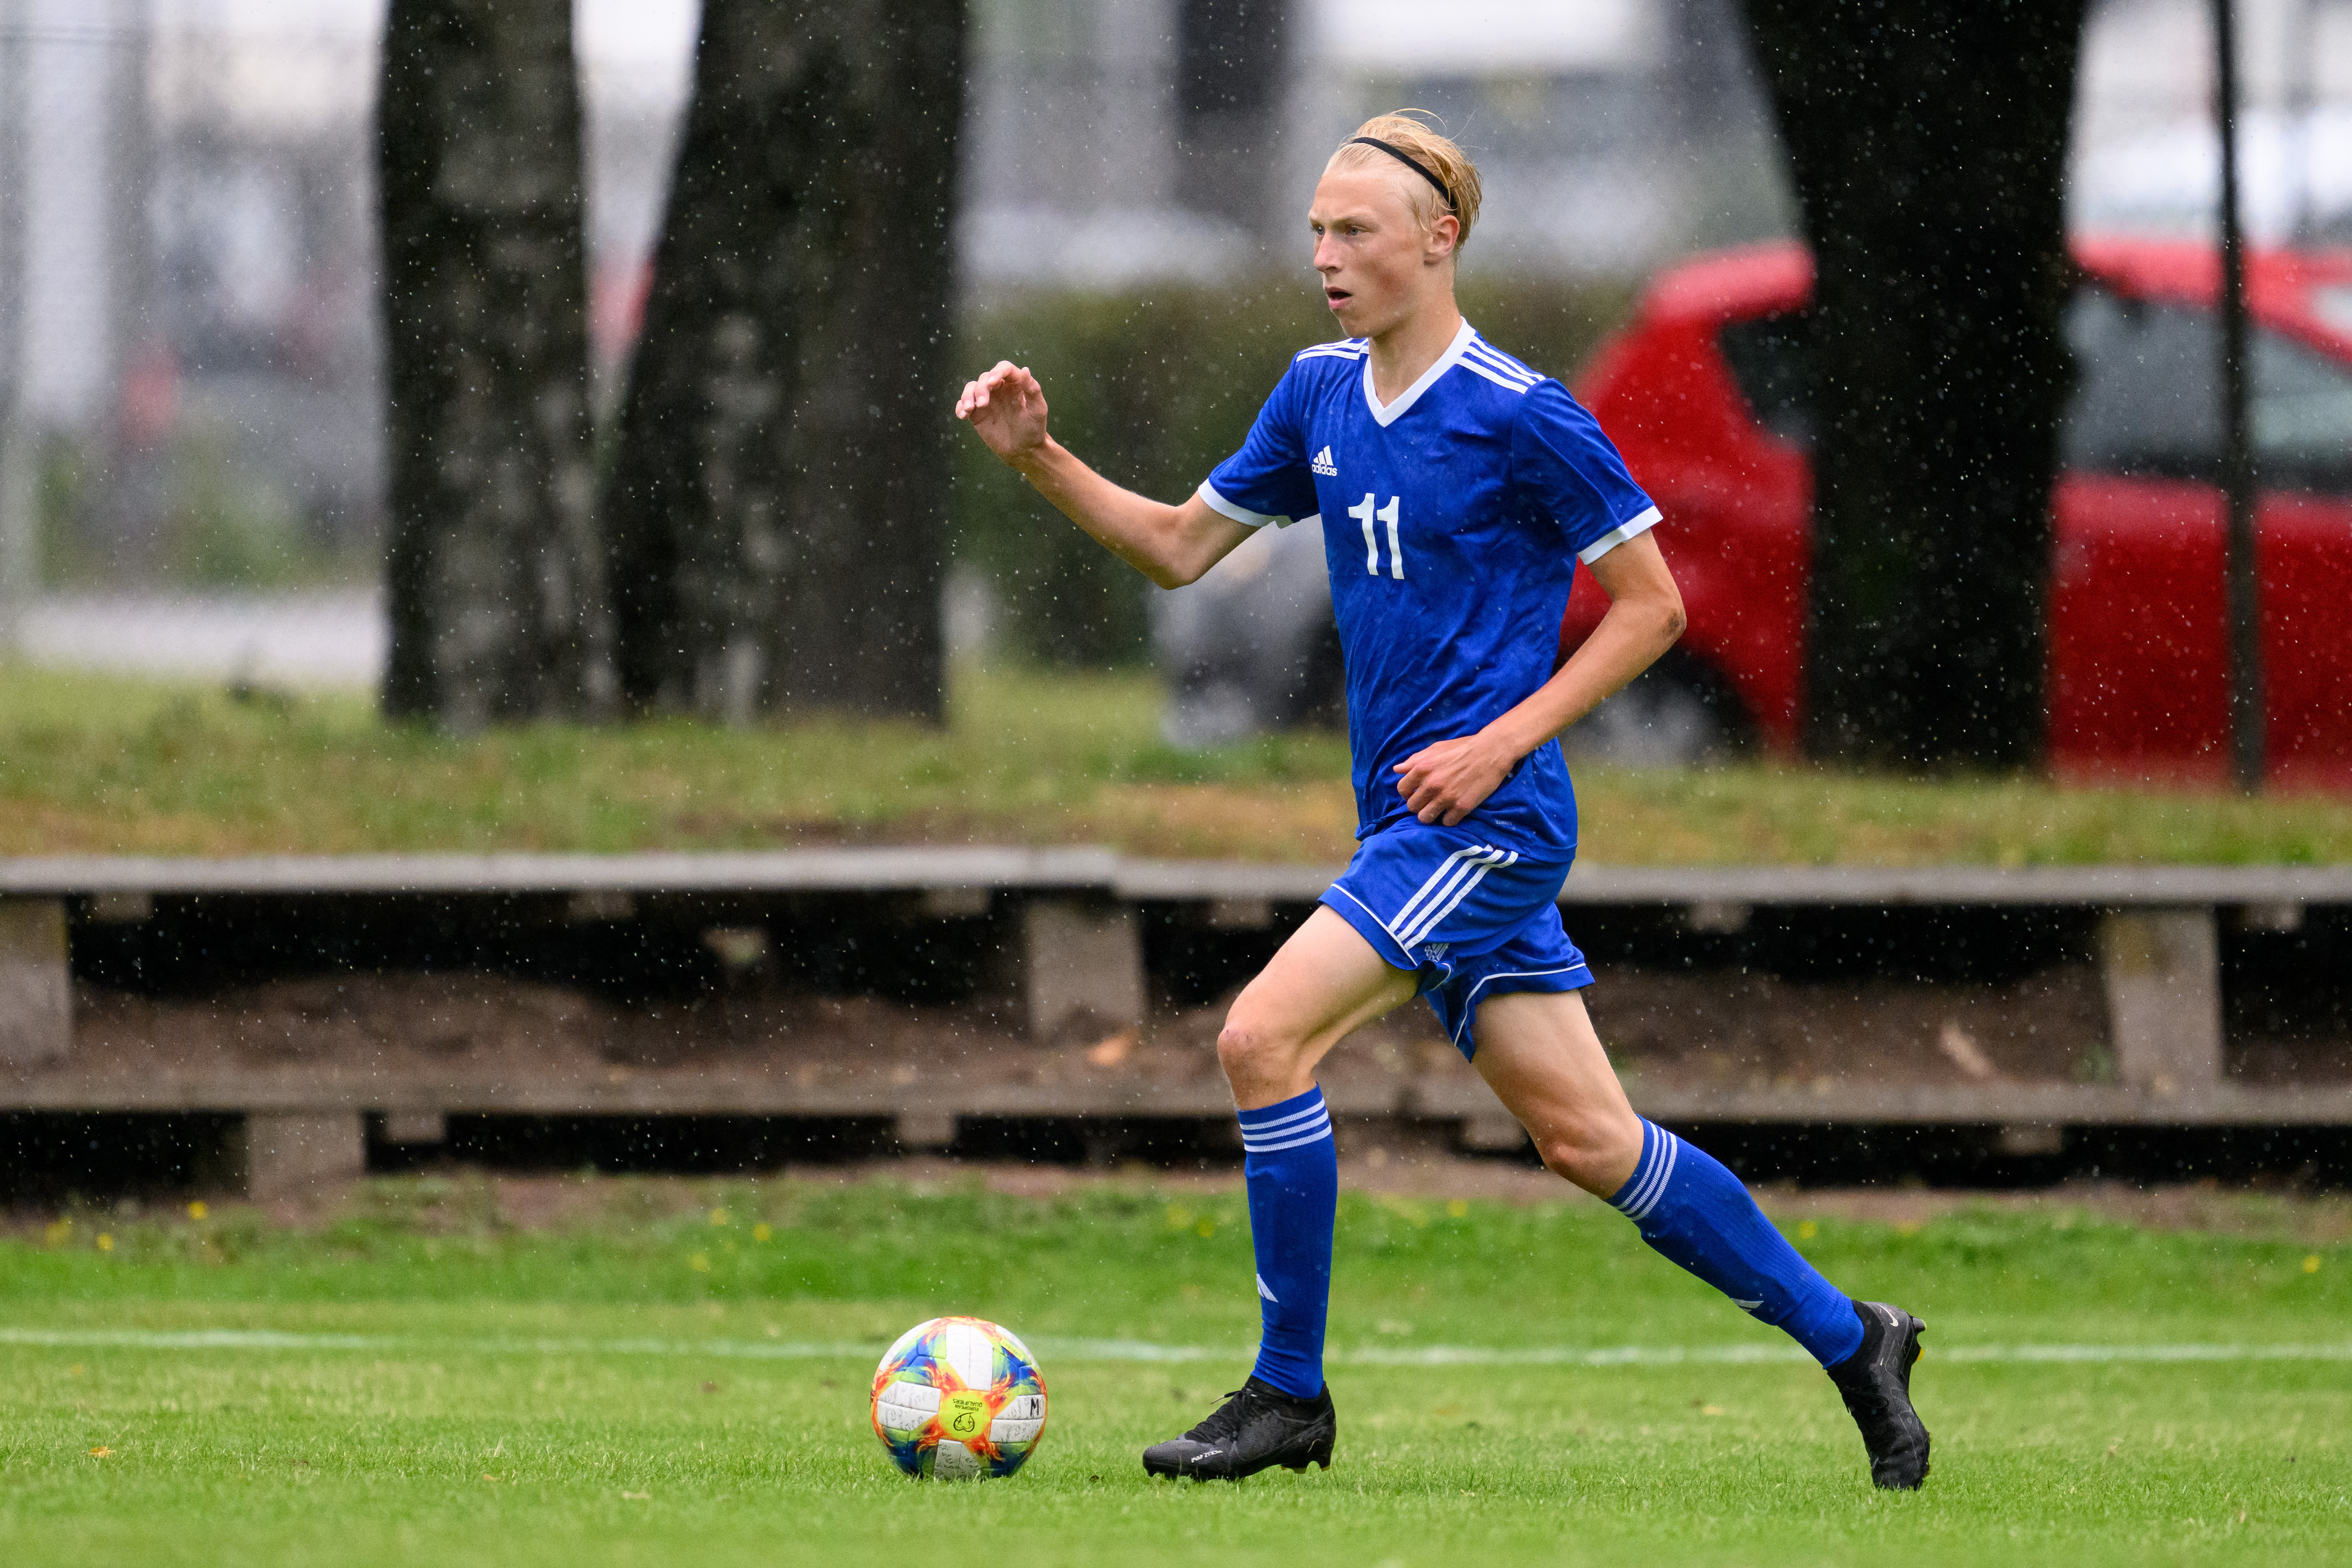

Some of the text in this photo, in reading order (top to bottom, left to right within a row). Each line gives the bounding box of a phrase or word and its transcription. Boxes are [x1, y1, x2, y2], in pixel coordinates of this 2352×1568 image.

[1312, 463, 1337, 476] adidas
[1348, 493, 1404, 579] 11
[953, 1398, 983, 1407] QUALIFIERS
